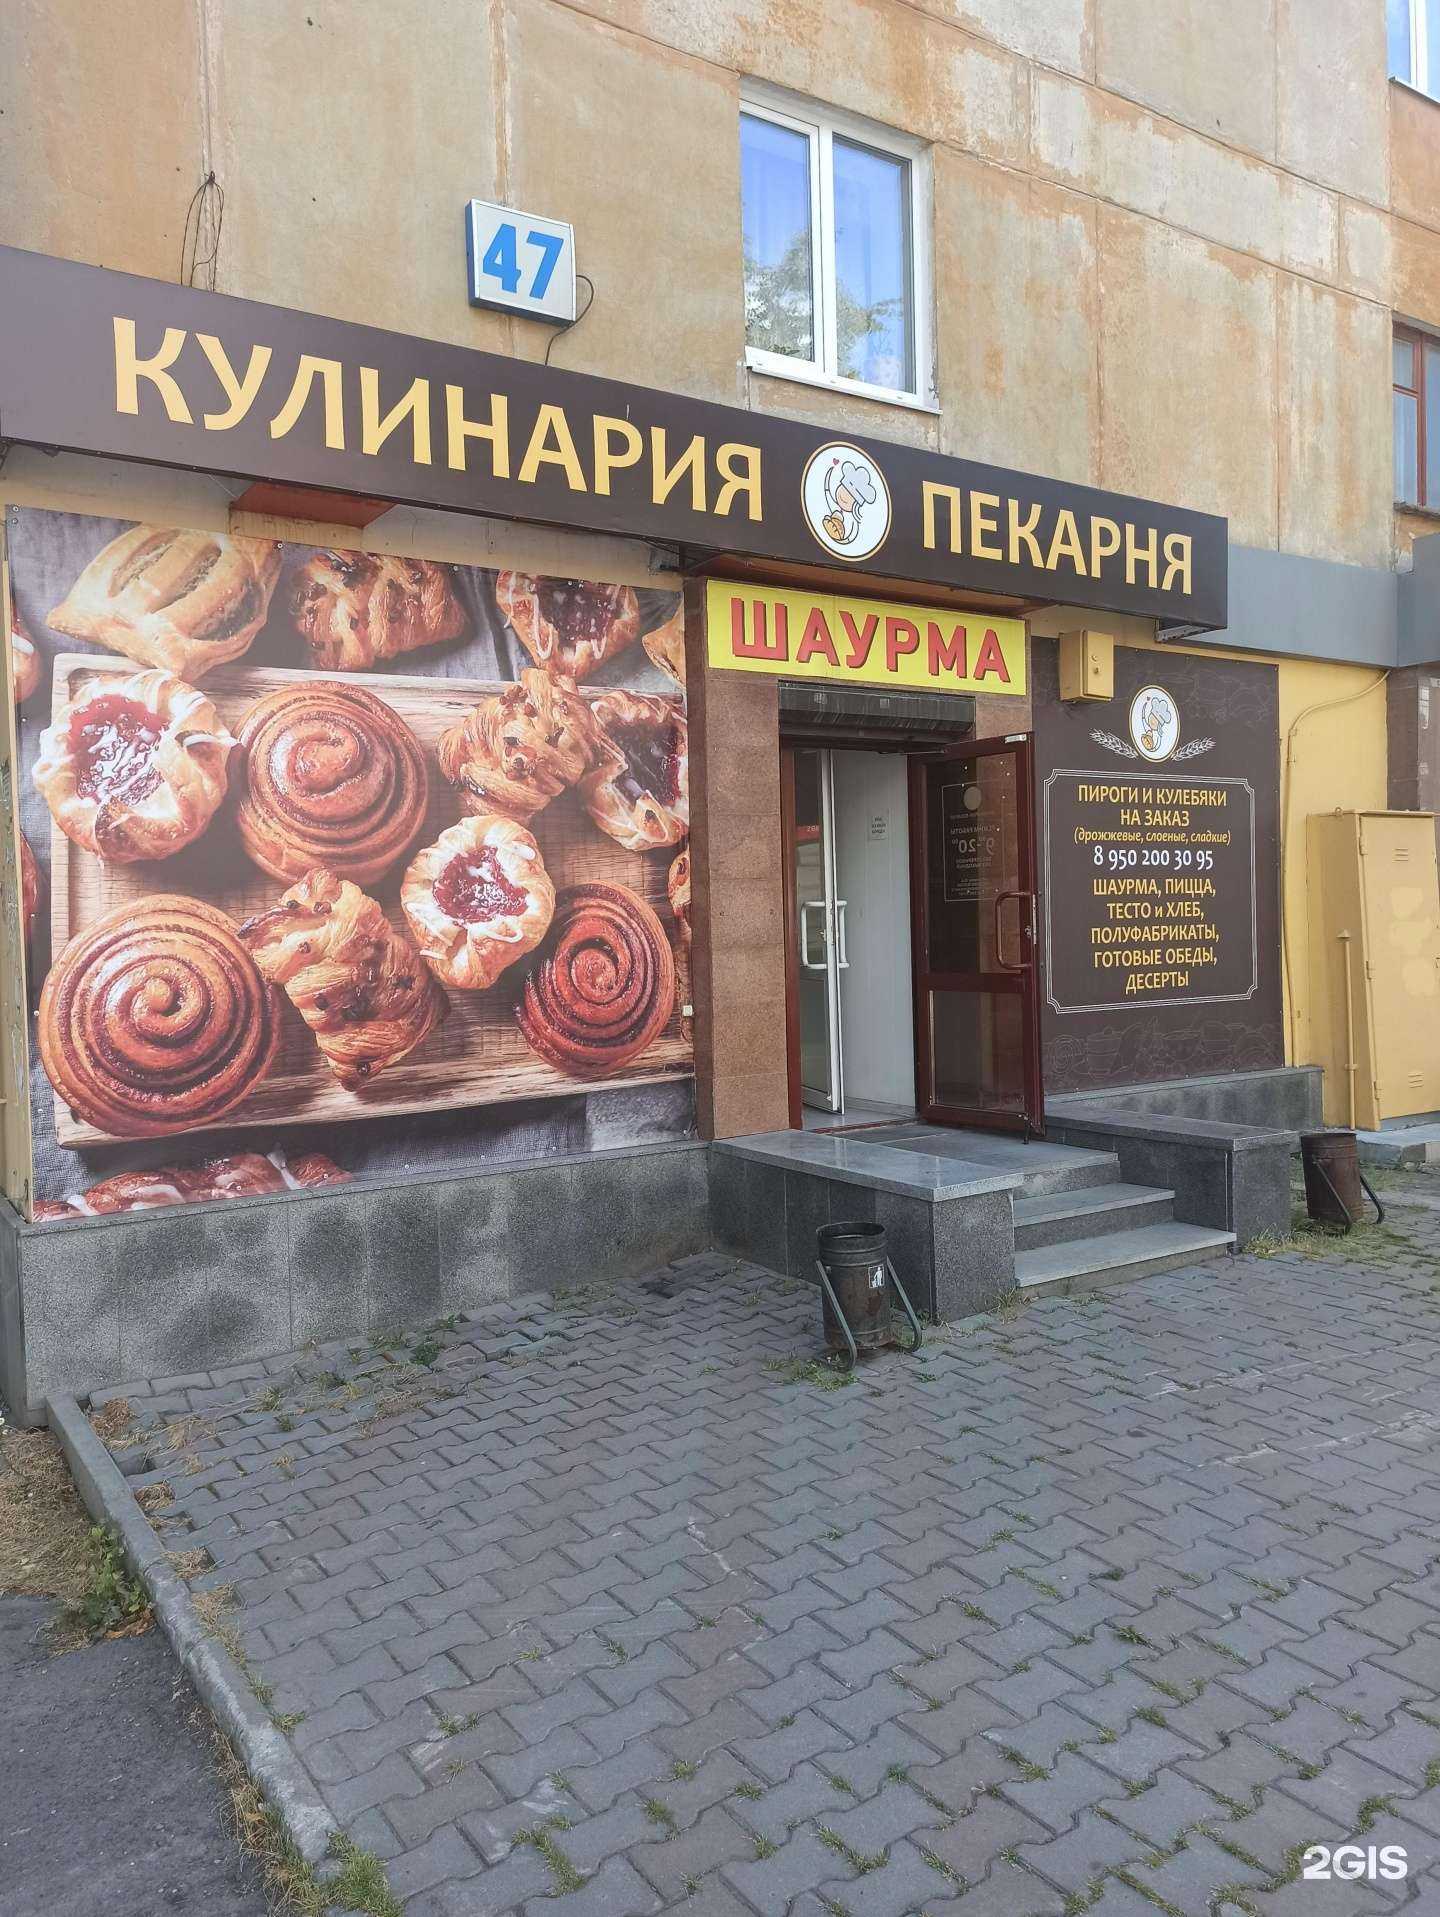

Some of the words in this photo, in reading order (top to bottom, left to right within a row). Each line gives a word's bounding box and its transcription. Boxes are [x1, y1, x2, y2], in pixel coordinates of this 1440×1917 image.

[483, 223, 564, 300] 47
[112, 316, 764, 522] КУЛИНАРИЯ
[922, 480, 1192, 595] ПЕКАРНЯ
[730, 597, 1011, 683] ШАУРМА
[1078, 785, 1138, 803] ПИРОГИ
[1142, 788, 1151, 804] И
[1156, 788, 1227, 807] КУЛЕБЯКИ
[1120, 809, 1141, 825] НА
[1144, 809, 1190, 827] ЗАКАЗ
[1074, 826, 1144, 845] (дрожжевые,
[1146, 830, 1189, 845] слоеные,
[1190, 830, 1231, 846] сладкие)
[1093, 845, 1104, 866] 8
[1108, 849, 1137, 871] 950
[1142, 850, 1170, 866] 200
[1174, 850, 1192, 870] 30
[1196, 850, 1213, 871] 95
[1093, 879, 1162, 898] ШАУРМА,
[1165, 878, 1216, 898] ПИЦЦА,
[1107, 902, 1151, 919] ТЕСТО
[1154, 905, 1163, 918] и
[1166, 901, 1204, 920] ХЛЕБ,
[1091, 923, 1219, 944] ПОЛУФАБРИКАТЫ,
[1094, 949, 1162, 968] ГОТОВЫЕ
[1165, 946, 1218, 967] ОБЕДЫ,
[1125, 971, 1189, 995] ДЕСЕРТЫ
